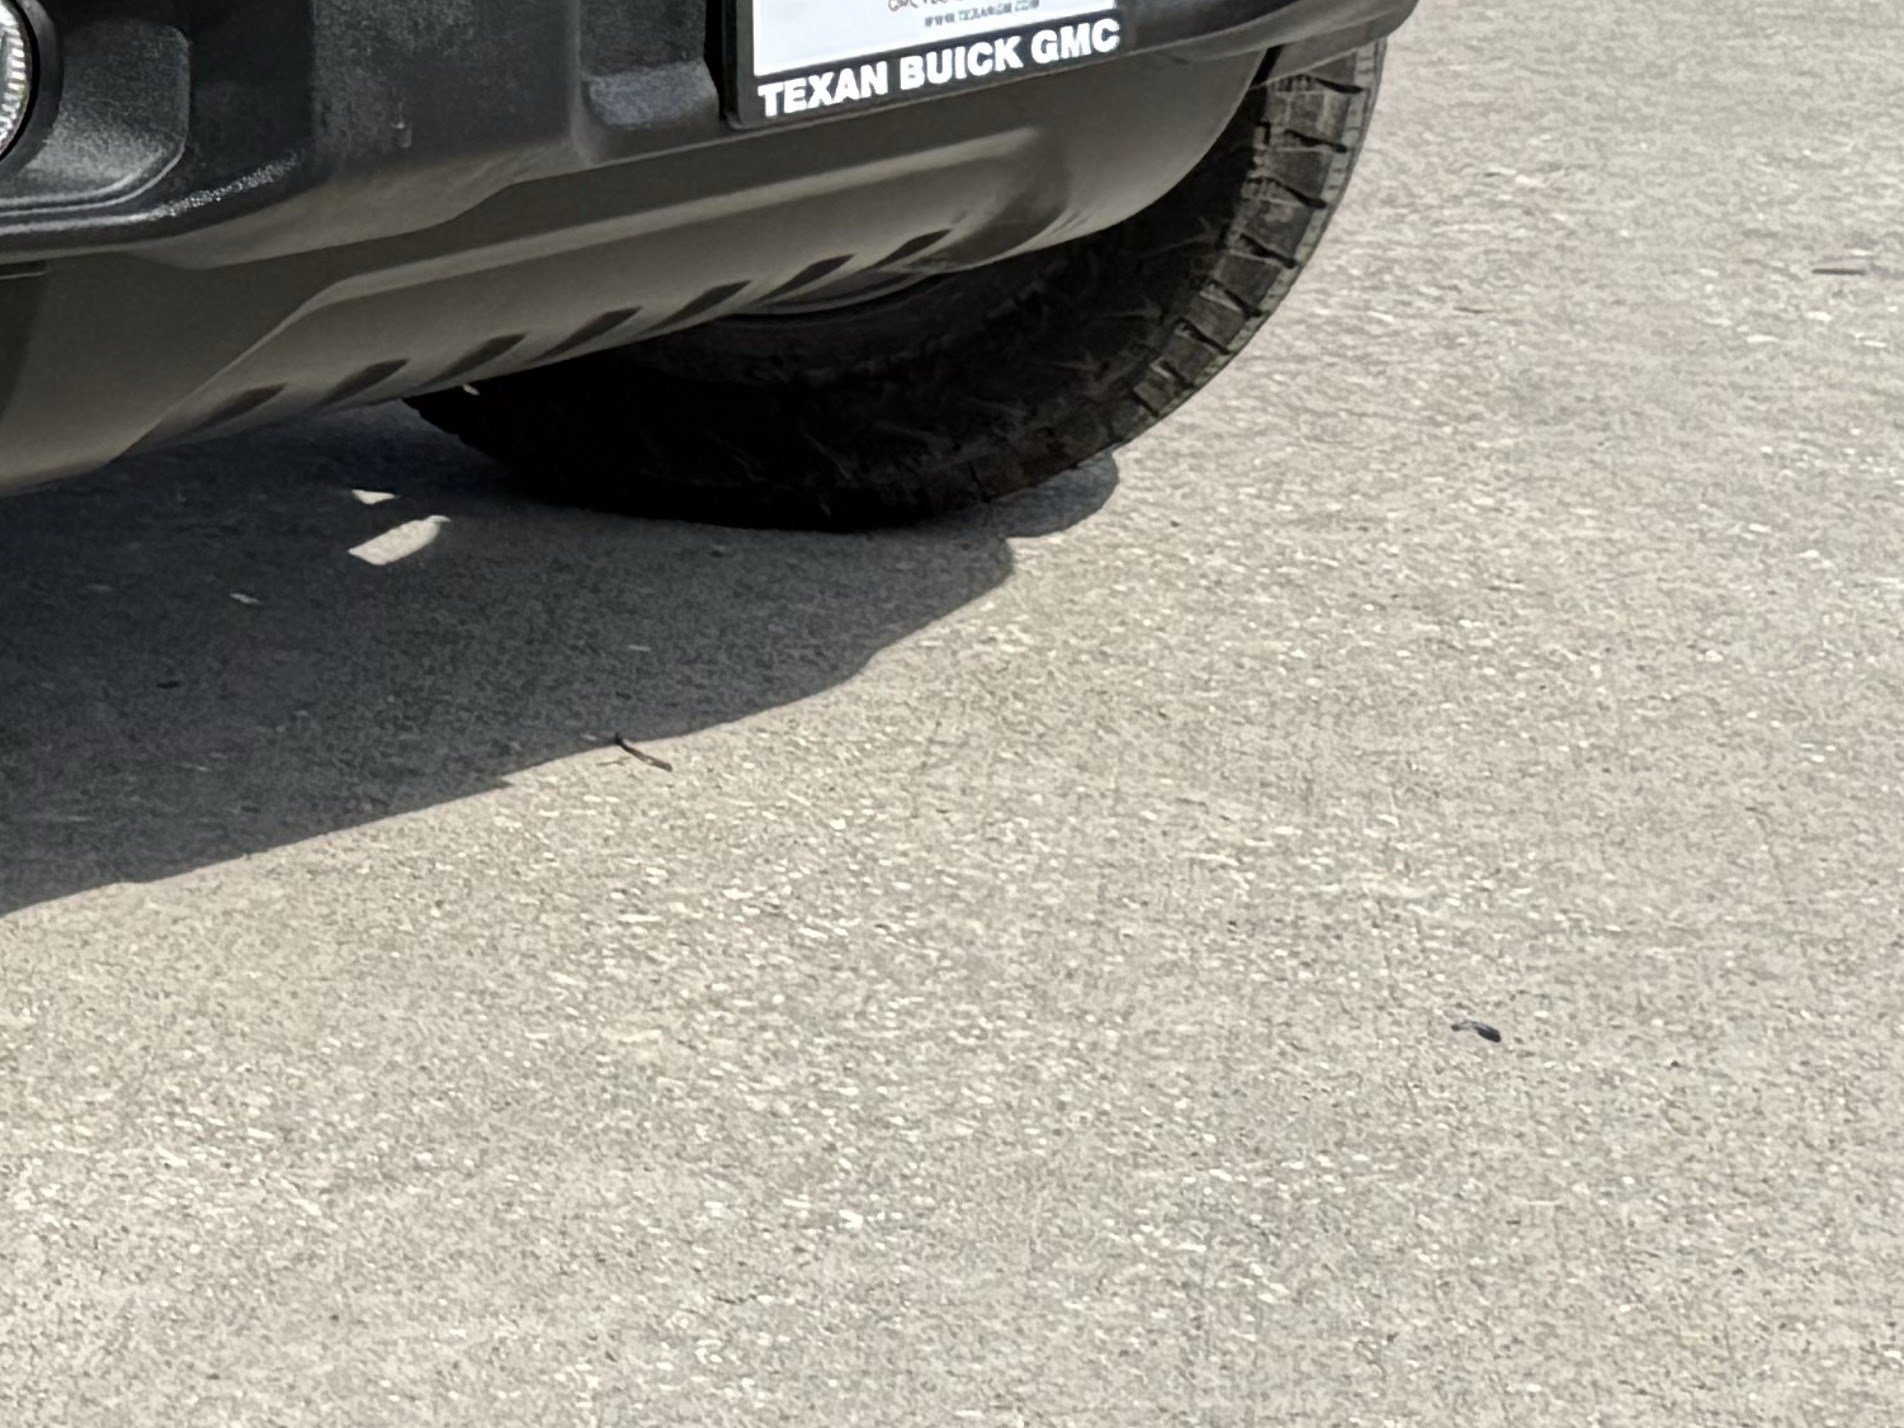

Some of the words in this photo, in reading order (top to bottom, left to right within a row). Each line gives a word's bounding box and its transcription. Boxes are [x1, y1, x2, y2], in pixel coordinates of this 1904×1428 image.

[757, 61, 888, 118] TEXAN
[899, 36, 1024, 91] BUICK
[1031, 17, 1121, 64] GMC
